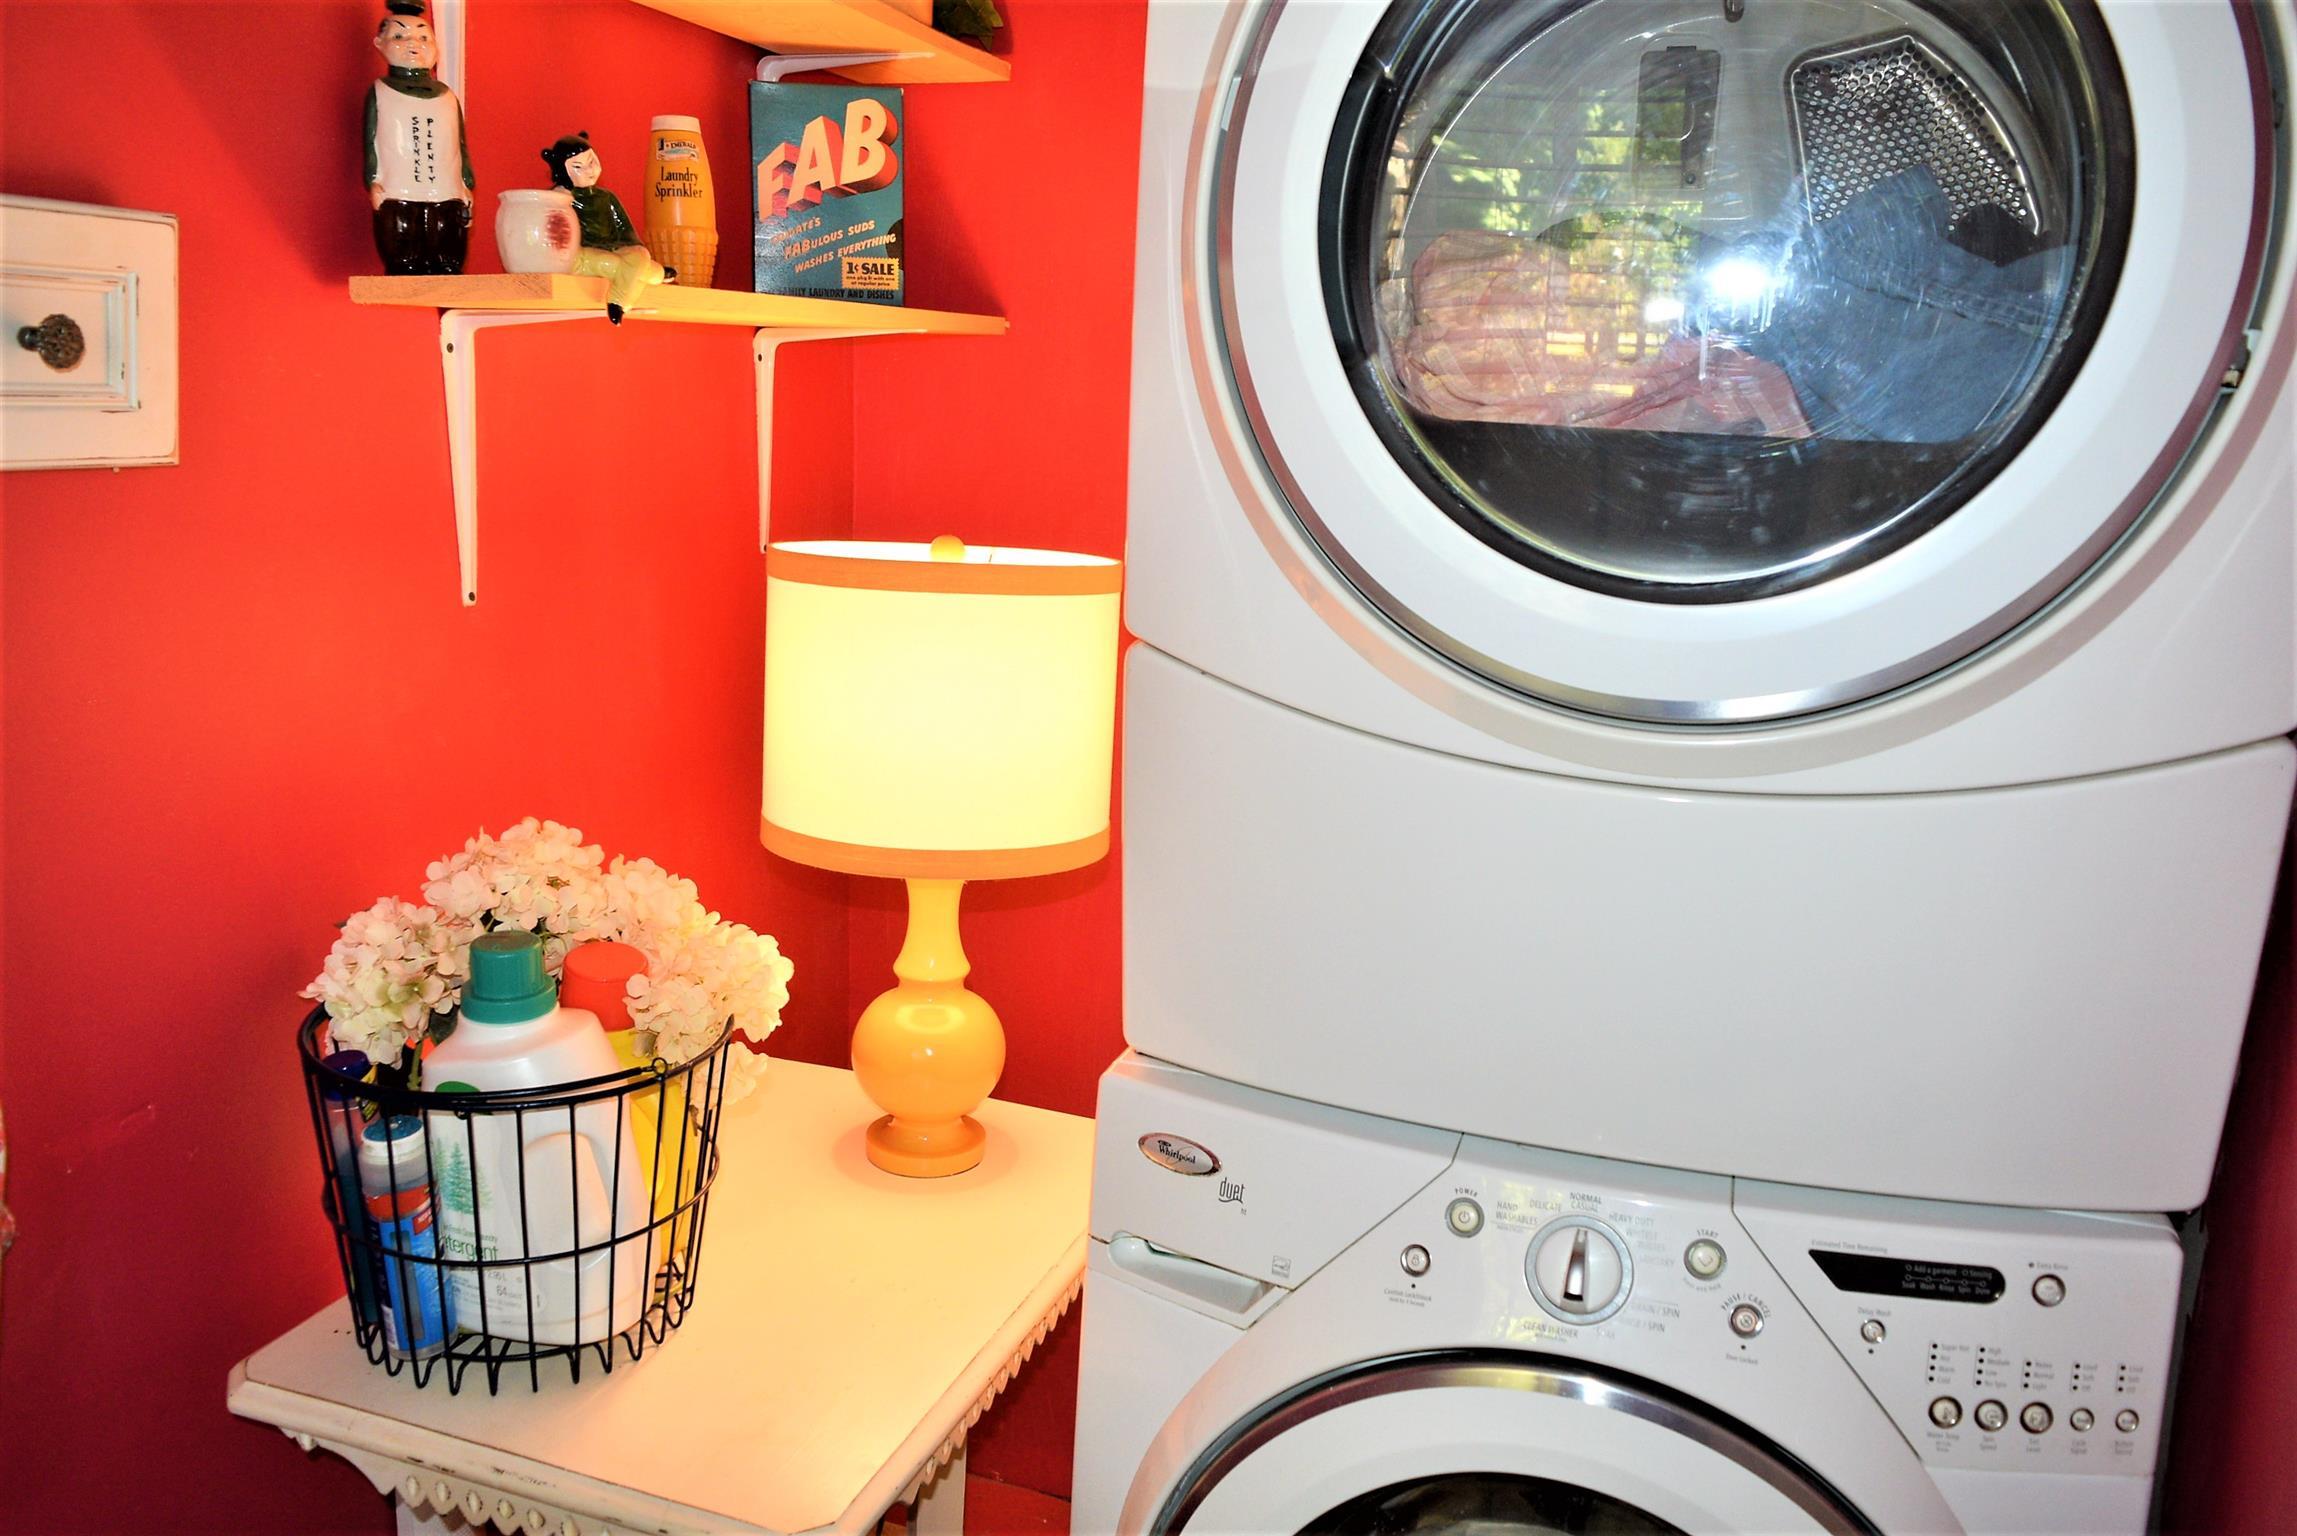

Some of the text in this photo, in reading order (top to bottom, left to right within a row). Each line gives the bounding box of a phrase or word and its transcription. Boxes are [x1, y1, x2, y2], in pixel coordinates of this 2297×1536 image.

[758, 98, 898, 222] FAB
[661, 166, 699, 186] Laundry
[655, 182, 703, 202] Sprinkler
[783, 220, 876, 260] FABULOUS SUDS
[794, 233, 897, 274] WASHES EVERYTHING
[861, 262, 895, 276] SALE
[809, 287, 844, 299] LAUNDRY
[847, 289, 864, 298] AND
[867, 290, 895, 300] DISHES
[1159, 1144, 1196, 1164] Whirlpool
[1219, 1177, 1245, 1202] duet
[1454, 1187, 1479, 1198] POWER
[1570, 1192, 1602, 1205] NORMAL
[1497, 1201, 1519, 1211] HAND
[1529, 1199, 1562, 1213] DELICATE
[1696, 1229, 1719, 1239] START
[1523, 1321, 1546, 1333] CLEAN
